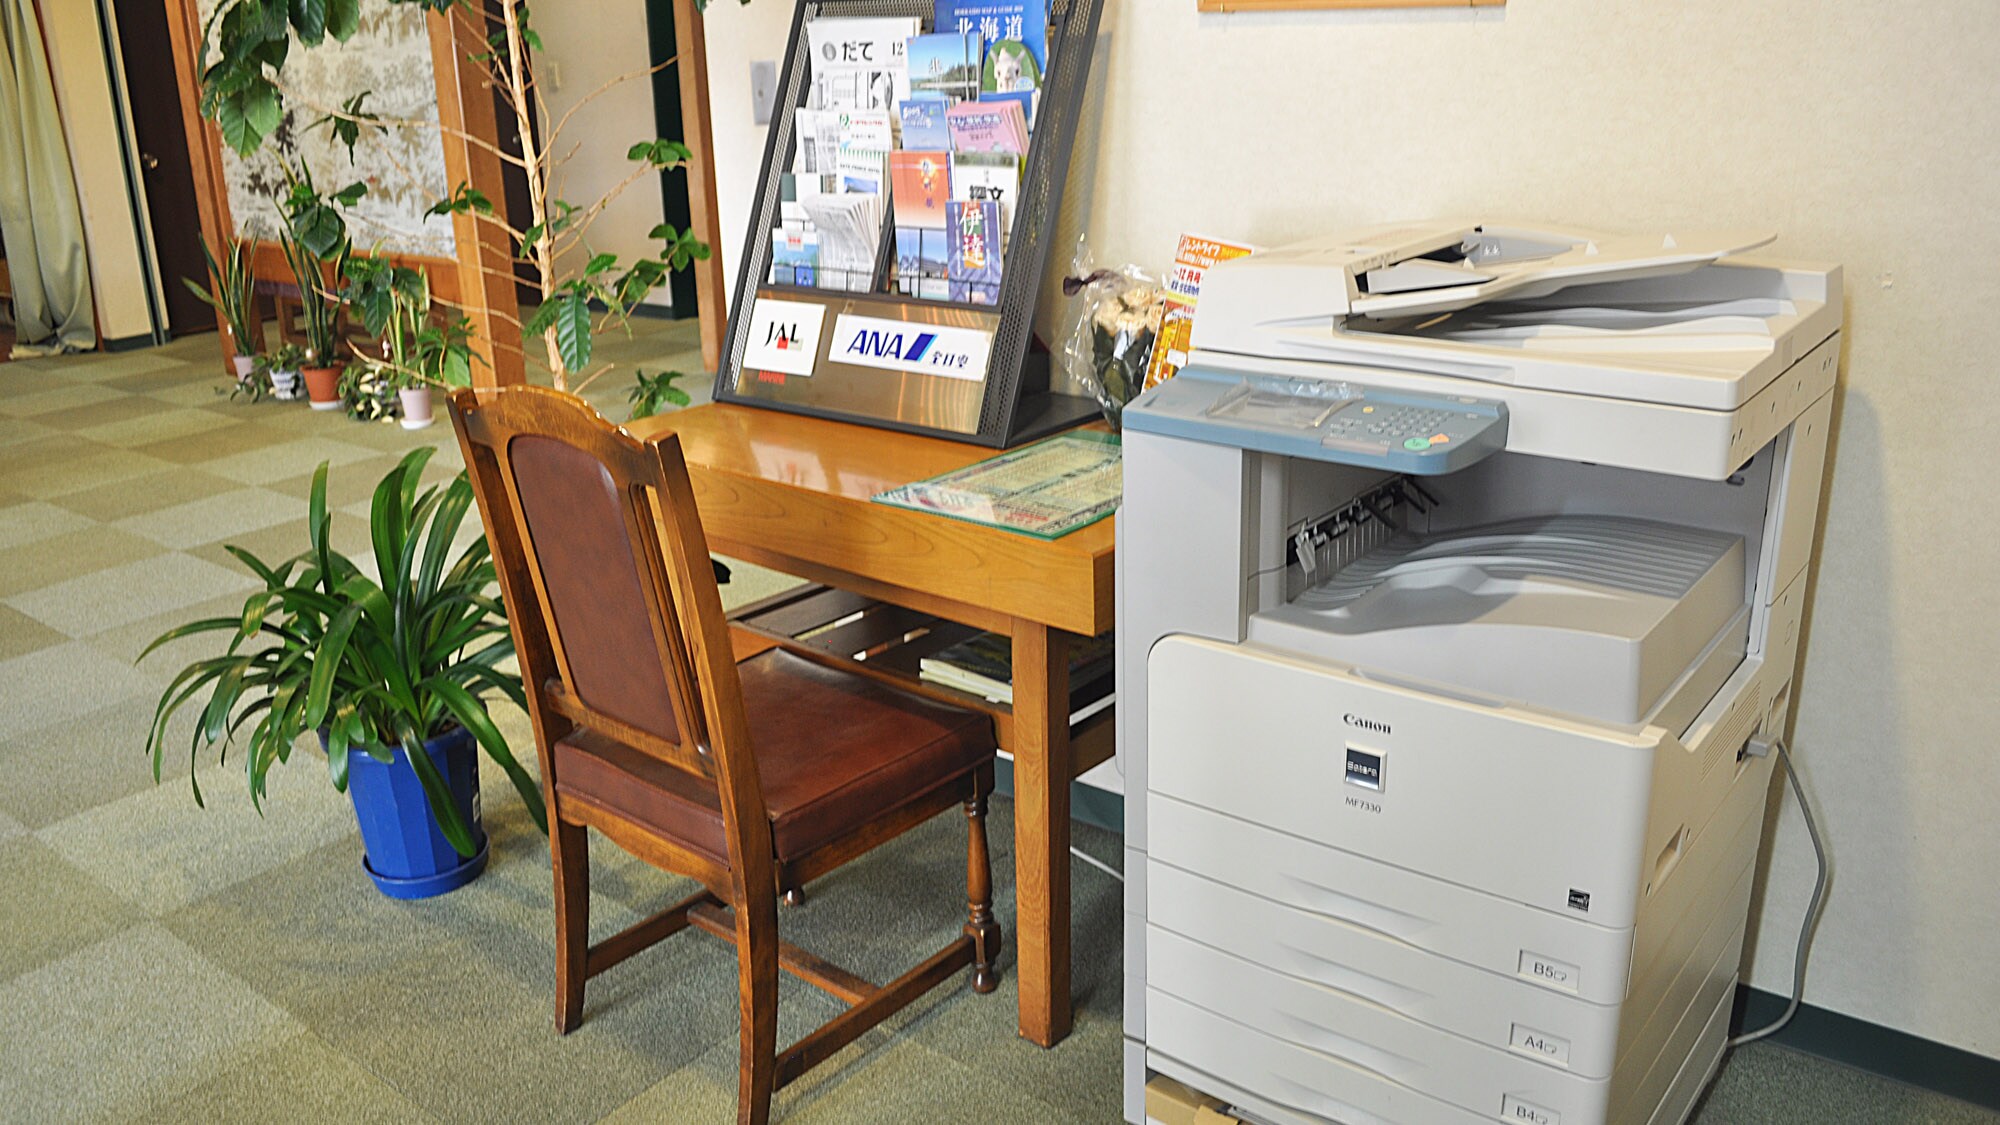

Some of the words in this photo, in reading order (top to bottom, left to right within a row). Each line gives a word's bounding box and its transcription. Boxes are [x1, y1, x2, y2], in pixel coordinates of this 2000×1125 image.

[842, 41, 873, 61] だて
[892, 42, 903, 56] 12
[960, 205, 986, 267] 伊達
[764, 321, 800, 347] JAL
[846, 329, 904, 360] ANA
[1343, 713, 1391, 734] Canon
[1345, 796, 1381, 813] MF7330
